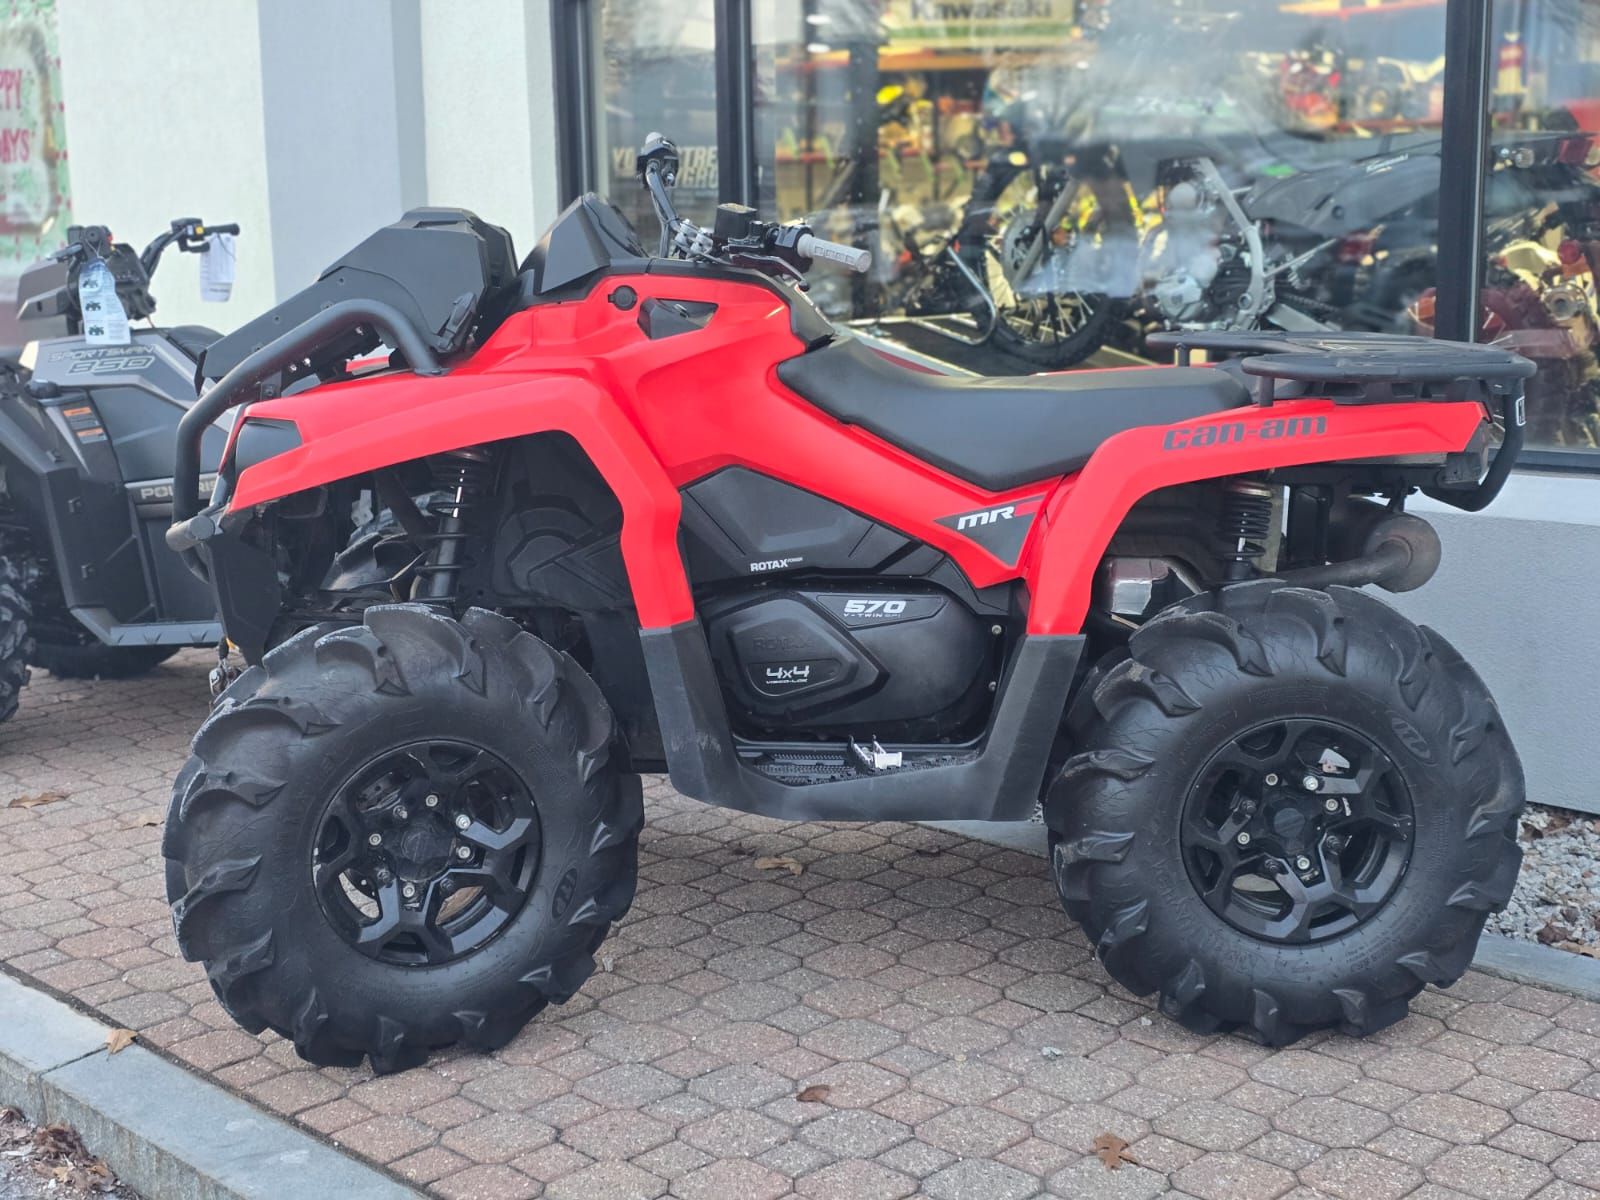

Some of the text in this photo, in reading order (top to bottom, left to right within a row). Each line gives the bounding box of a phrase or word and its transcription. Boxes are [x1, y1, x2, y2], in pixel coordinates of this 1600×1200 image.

[957, 505, 1015, 531] MR
[750, 558, 788, 573] ROTAX
[844, 599, 907, 614] 570
[766, 665, 810, 679] 4x4
